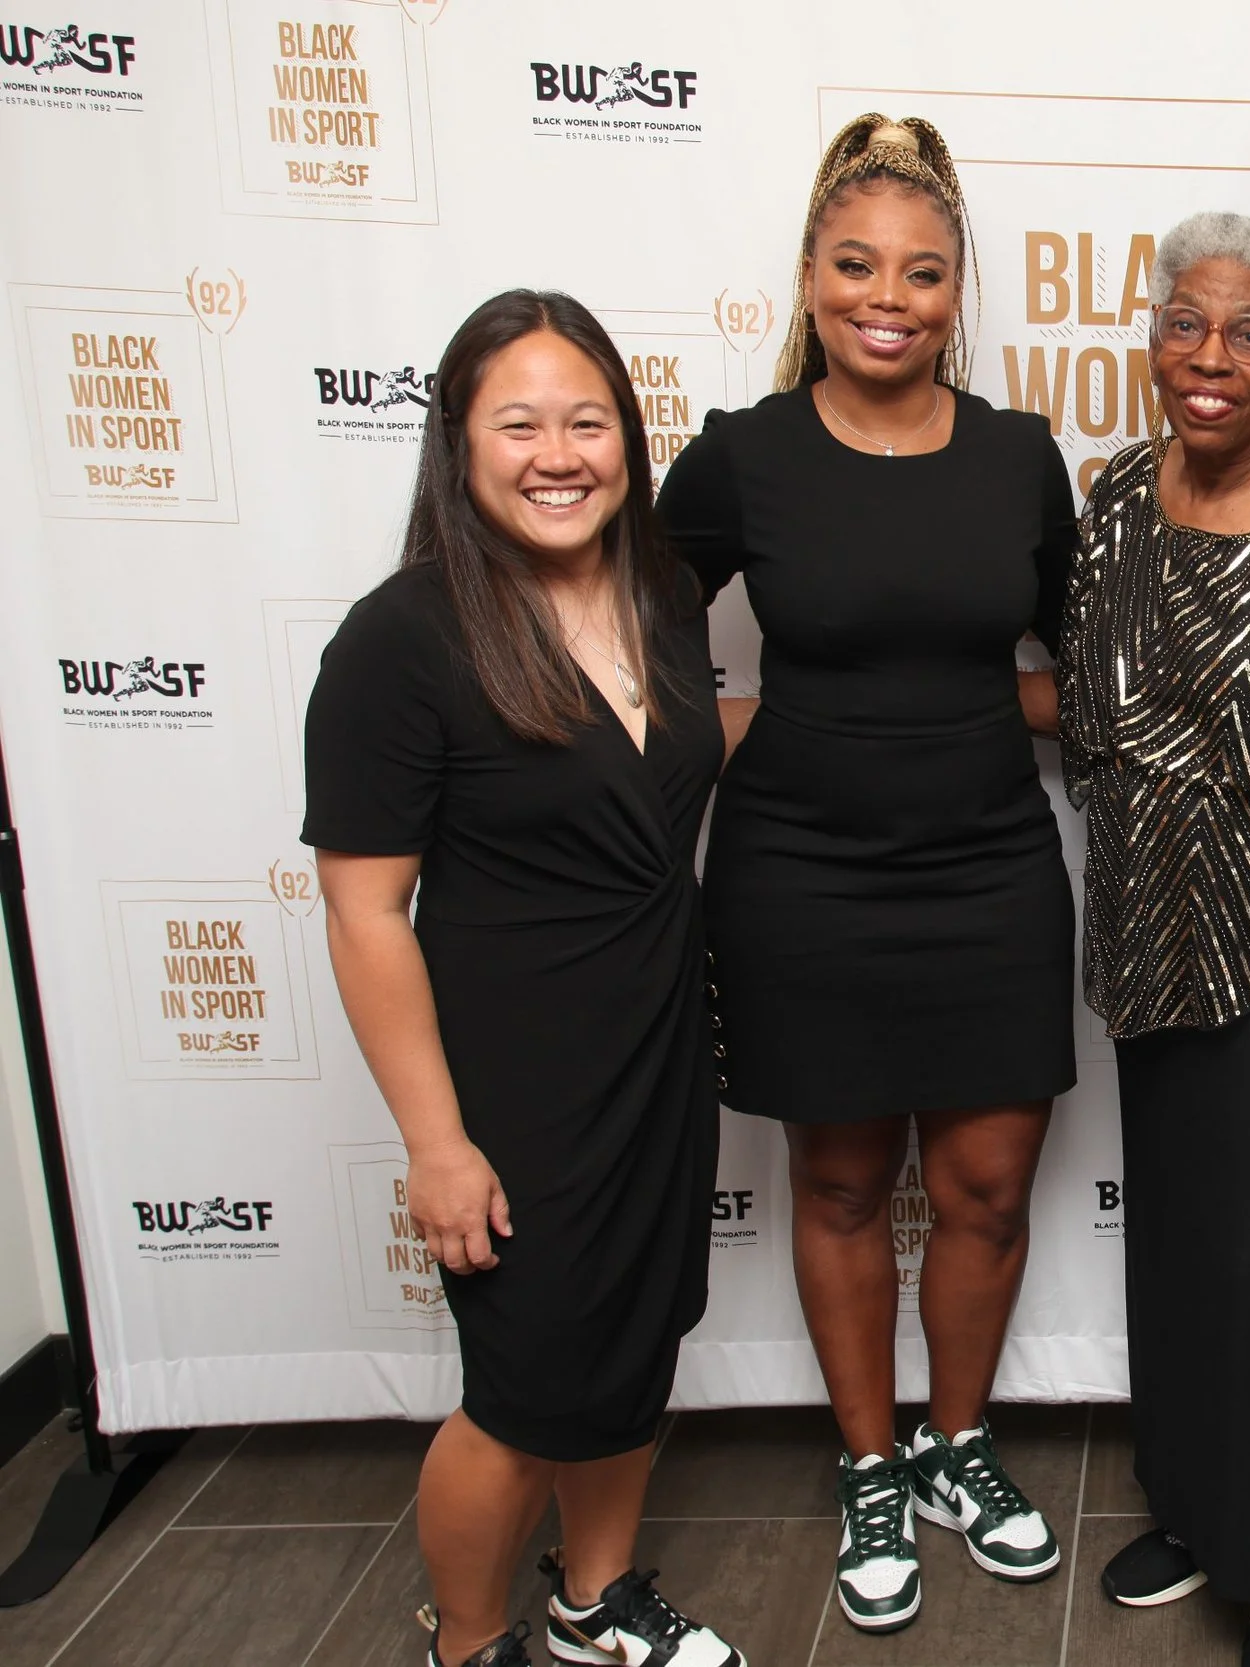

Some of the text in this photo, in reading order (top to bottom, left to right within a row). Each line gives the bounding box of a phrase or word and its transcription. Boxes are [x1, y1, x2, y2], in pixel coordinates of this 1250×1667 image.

[0, 24, 136, 76] WSF
[278, 21, 358, 61] BLACK
[3, 82, 38, 92] WOMEN
[41, 85, 50, 93] IN
[54, 87, 82, 96] SPORT
[85, 89, 143, 100] FOUNDATION
[273, 64, 369, 104] WOMEN
[6, 97, 73, 109] ESTABLISHED
[91, 104, 112, 112] 1992
[268, 107, 380, 147] IN SPORT
[532, 117, 561, 126] BLACK
[564, 118, 598, 127] WOMEN
[613, 121, 641, 130] SPORT
[644, 122, 702, 132] FOUNDATION
[566, 132, 631, 142] ESTABLISHED
[649, 136, 670, 144] 1992
[1025, 231, 1157, 327] BLA
[199, 281, 232, 315] 92
[728, 303, 760, 334] 92
[72, 333, 160, 370] BLACK
[630, 355, 681, 389] ACK
[68, 374, 171, 411] WOMEN
[1002, 345, 1168, 438] WOM
[317, 419, 341, 427] BLACK
[343, 420, 373, 429] WOMEN
[387, 422, 415, 430] SPORT
[635, 394, 689, 427] MEN
[66, 414, 182, 451] IN SPORT
[345, 434, 404, 443] ESTABLISHED
[63, 708, 213, 718] BLACK WOMEN IN SPORT FOUNDATION
[88, 721, 149, 729] ESTABLISHED
[164, 722, 183, 730] 1992
[281, 871, 311, 900] 92
[166, 920, 245, 950] BLACK
[163, 955, 256, 985] WOMEN
[160, 990, 266, 1019] IN SPORT
[161, 1243, 192, 1252] WOMEN
[712, 1230, 757, 1238] OUNDATION
[162, 1253, 219, 1262] ESTABLISHED
[386, 1244, 410, 1272] IN
